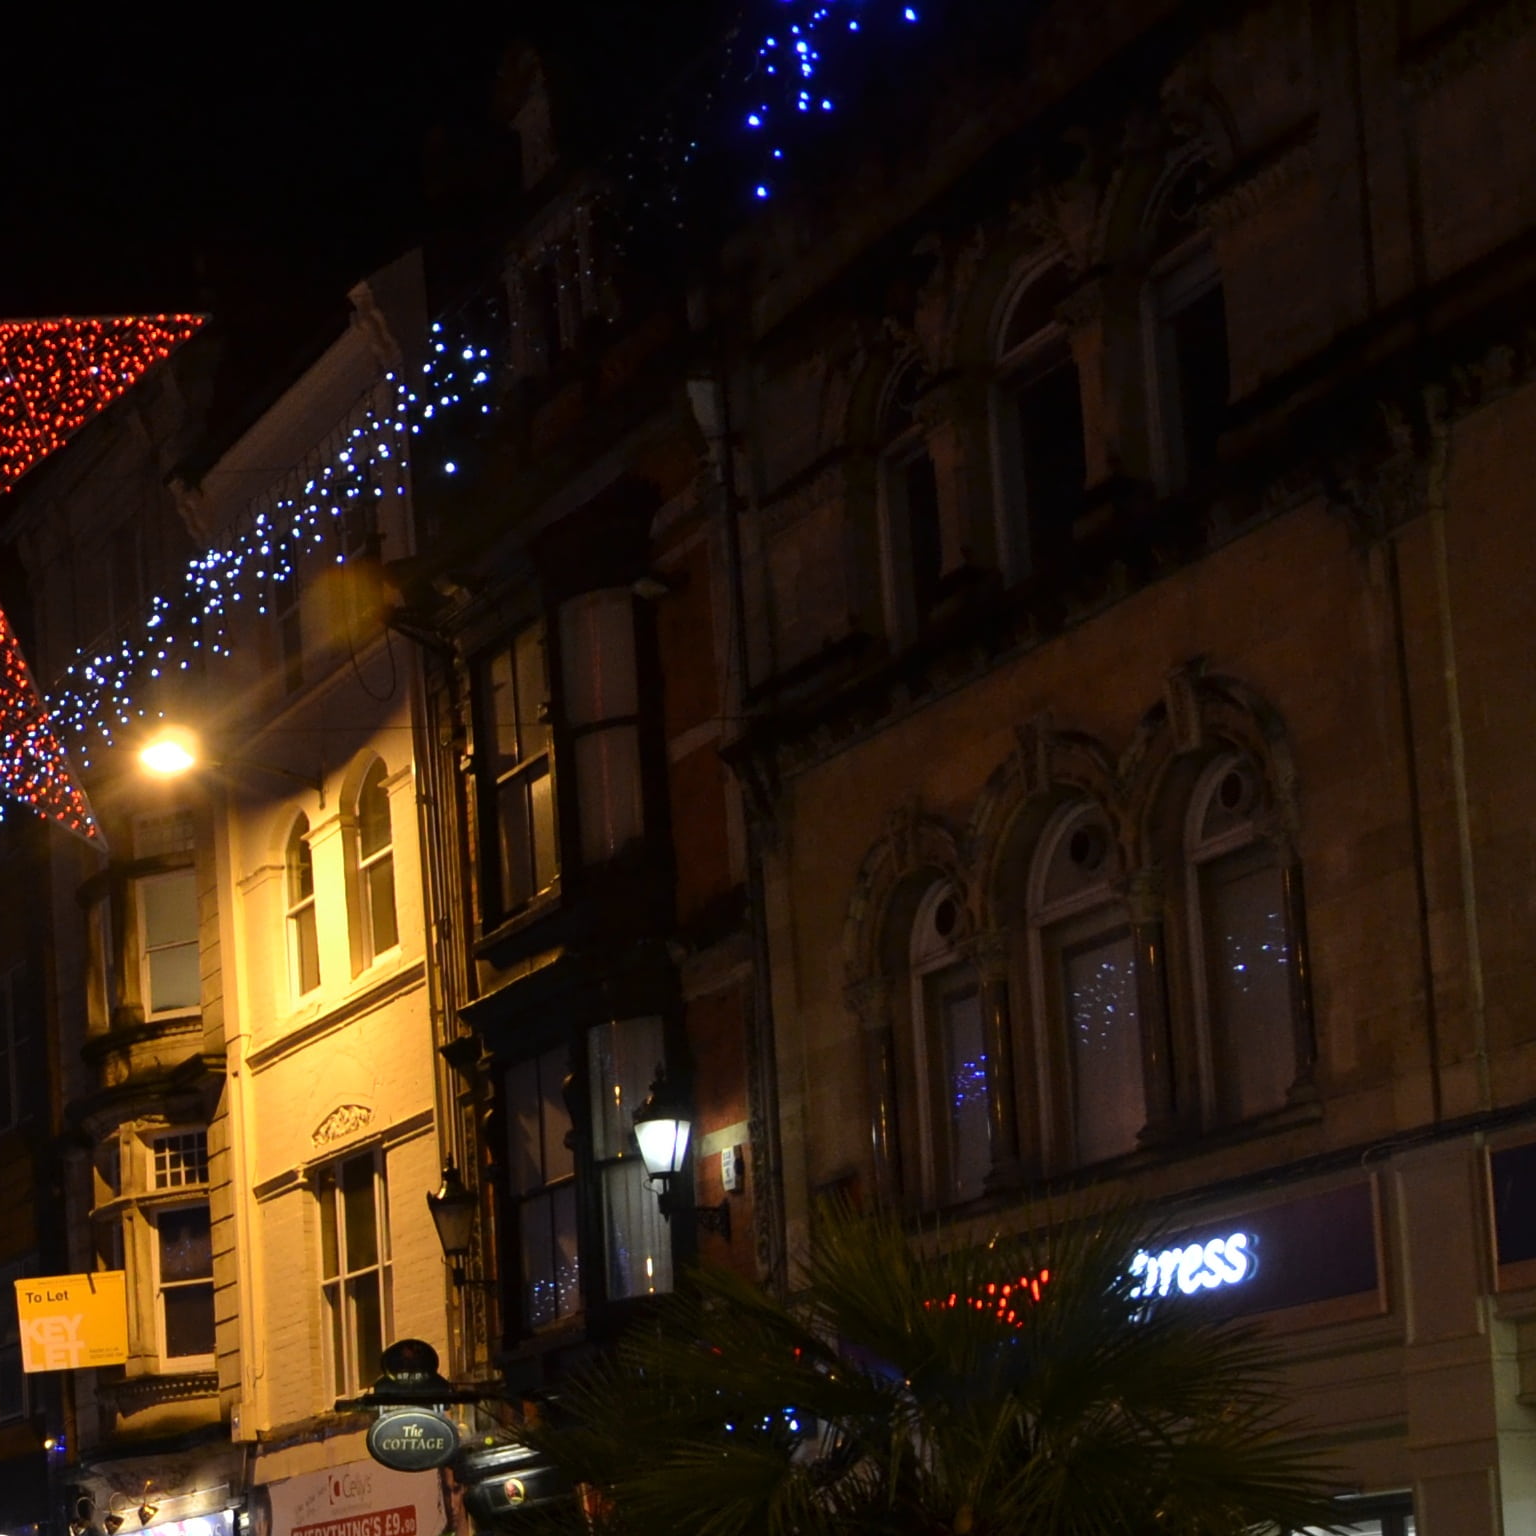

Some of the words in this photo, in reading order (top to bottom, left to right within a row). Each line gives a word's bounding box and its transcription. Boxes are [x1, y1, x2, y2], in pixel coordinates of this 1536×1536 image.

[25, 1292, 42, 1304] To
[46, 1290, 69, 1302] Let
[21, 1313, 85, 1345] KEY
[401, 1423, 424, 1438] The
[382, 1437, 445, 1451] COTTAGE
[385, 1511, 416, 1536] £9.90
